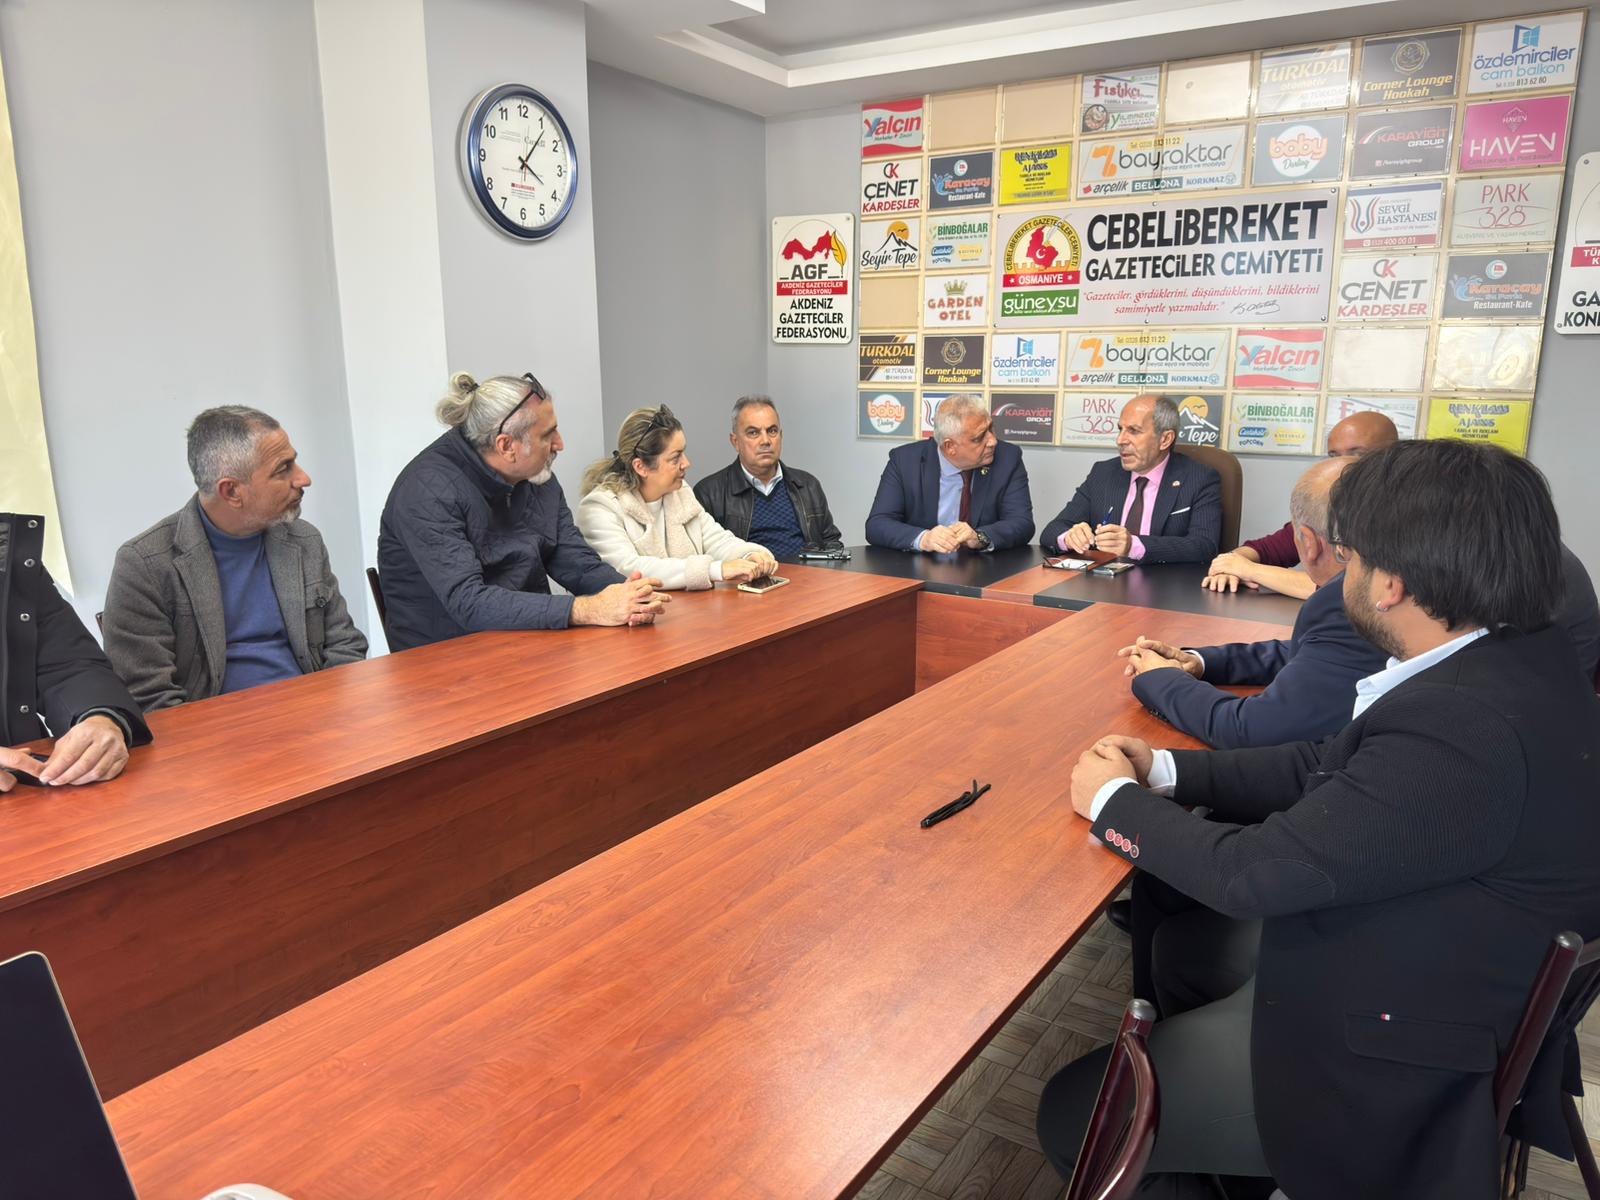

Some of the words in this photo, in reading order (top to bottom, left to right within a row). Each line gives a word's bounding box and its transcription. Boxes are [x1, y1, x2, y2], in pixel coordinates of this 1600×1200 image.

[1474, 46, 1576, 70] özdemirciler
[1480, 68, 1512, 81] cam
[1516, 62, 1565, 77] balkon
[1363, 79, 1404, 92] Corner
[1406, 74, 1453, 88] Lounge
[1383, 87, 1430, 100] Hookah
[498, 106, 508, 120] 11
[517, 104, 528, 118] 12
[538, 117, 543, 129] 1
[864, 115, 921, 137] Yalçın
[484, 124, 496, 138] 10
[553, 140, 558, 152] 2
[1269, 133, 1328, 160] baby
[1407, 138, 1445, 148] GROUP
[1470, 132, 1556, 158] HAVEN
[480, 148, 486, 161] 9
[1119, 143, 1232, 171] bayraktar
[557, 165, 563, 177] 3
[486, 177, 493, 190] 8
[1134, 179, 1181, 190] BELLONA
[1186, 176, 1224, 185] KORKMAZ
[864, 179, 919, 201] ÇENET
[1093, 181, 1129, 195] arçelik
[1482, 183, 1531, 203] PARK
[501, 197, 507, 209] 7
[551, 190, 557, 202] 4
[539, 204, 545, 216] 5
[863, 199, 920, 213] KARDEŞLER
[1378, 203, 1410, 215] SEVGİ
[520, 208, 526, 220] 6
[1377, 211, 1437, 225] HASTANESİ
[937, 222, 988, 236] BİNBOĞALAR
[1087, 200, 1328, 252] CEBELİBEREKET
[861, 250, 893, 271] Seyir
[892, 248, 917, 269] Tepe
[1086, 253, 1215, 281] GAZETECİLER
[1221, 248, 1323, 276] CEMİYETİ
[791, 264, 828, 280] AGF
[1267, 284, 1320, 295] bildiklerini
[1341, 279, 1428, 304] ÇENET
[928, 296, 983, 309] GARDEN
[1004, 293, 1077, 314] güneysu
[1114, 303, 1166, 316] samimiyetle
[1473, 300, 1533, 309] Restaurant-Kafe
[939, 310, 971, 321] OTEL
[1337, 303, 1428, 317] KARDEŞLER
[1563, 312, 1600, 327] KON
[776, 327, 847, 338] FEDERASYONU
[1106, 341, 1216, 365] bayraktar
[1239, 344, 1321, 370] Yalçın
[993, 356, 1057, 368] özdemirciler
[925, 367, 951, 375] Corner
[952, 367, 982, 376] Lounge
[998, 368, 1019, 377] cam
[1020, 367, 1050, 377] balkon
[1081, 372, 1115, 384] arçelik
[1120, 374, 1166, 383] BELLONA
[937, 375, 967, 383] Hookah
[1171, 375, 1209, 383] KORKMAZ
[867, 400, 905, 422] baby
[1083, 399, 1116, 414] PARK
[1247, 402, 1314, 418] BİNBOĞALAR
[1184, 425, 1218, 446] Tepe
